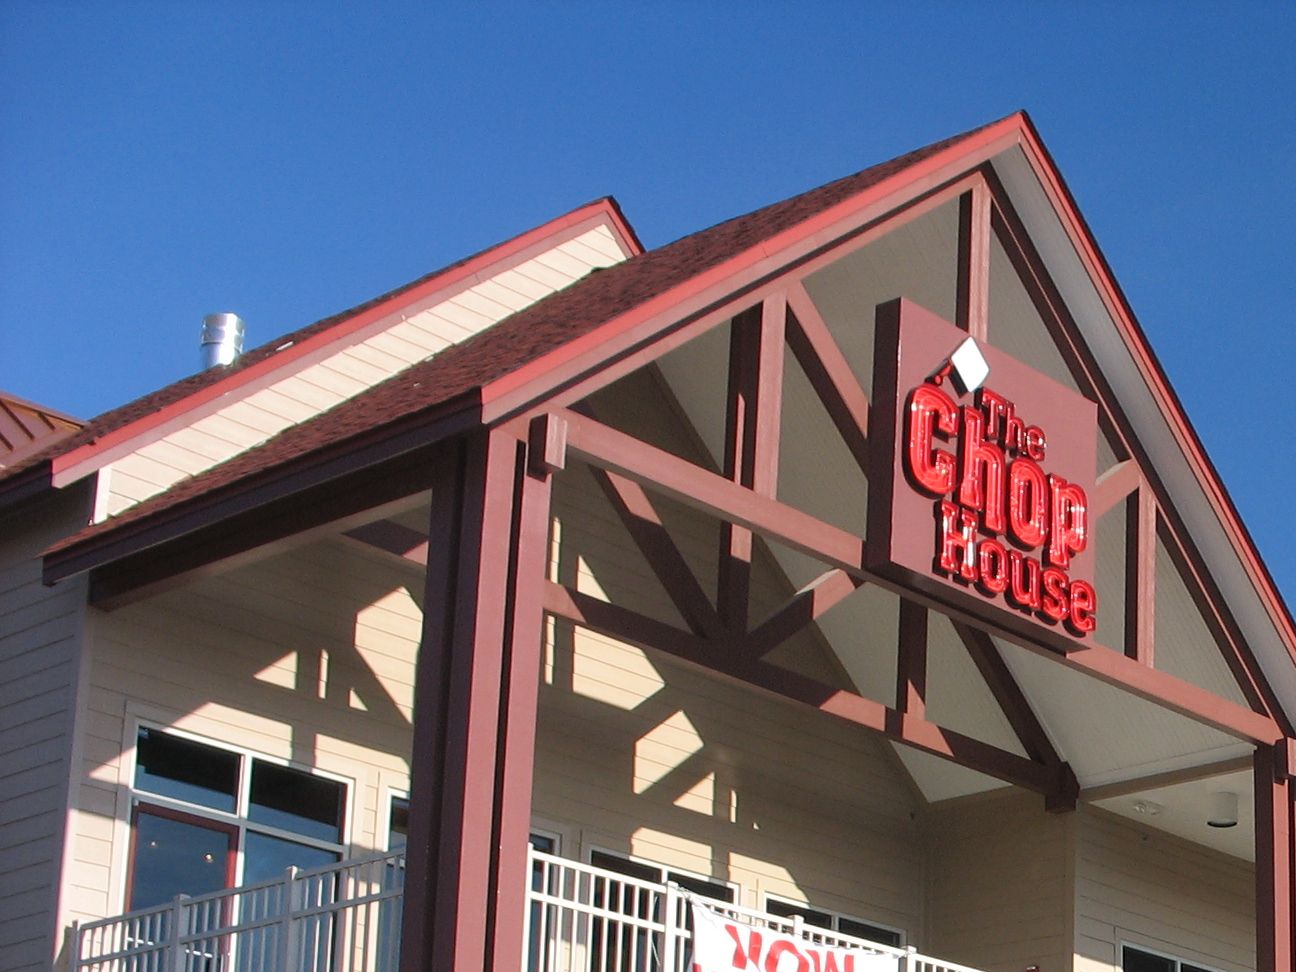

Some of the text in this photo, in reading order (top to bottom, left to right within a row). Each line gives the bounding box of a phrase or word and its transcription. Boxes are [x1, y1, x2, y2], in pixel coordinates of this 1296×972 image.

[908, 382, 1089, 571] Chop
[979, 387, 1048, 462] The
[939, 499, 1097, 634] House
